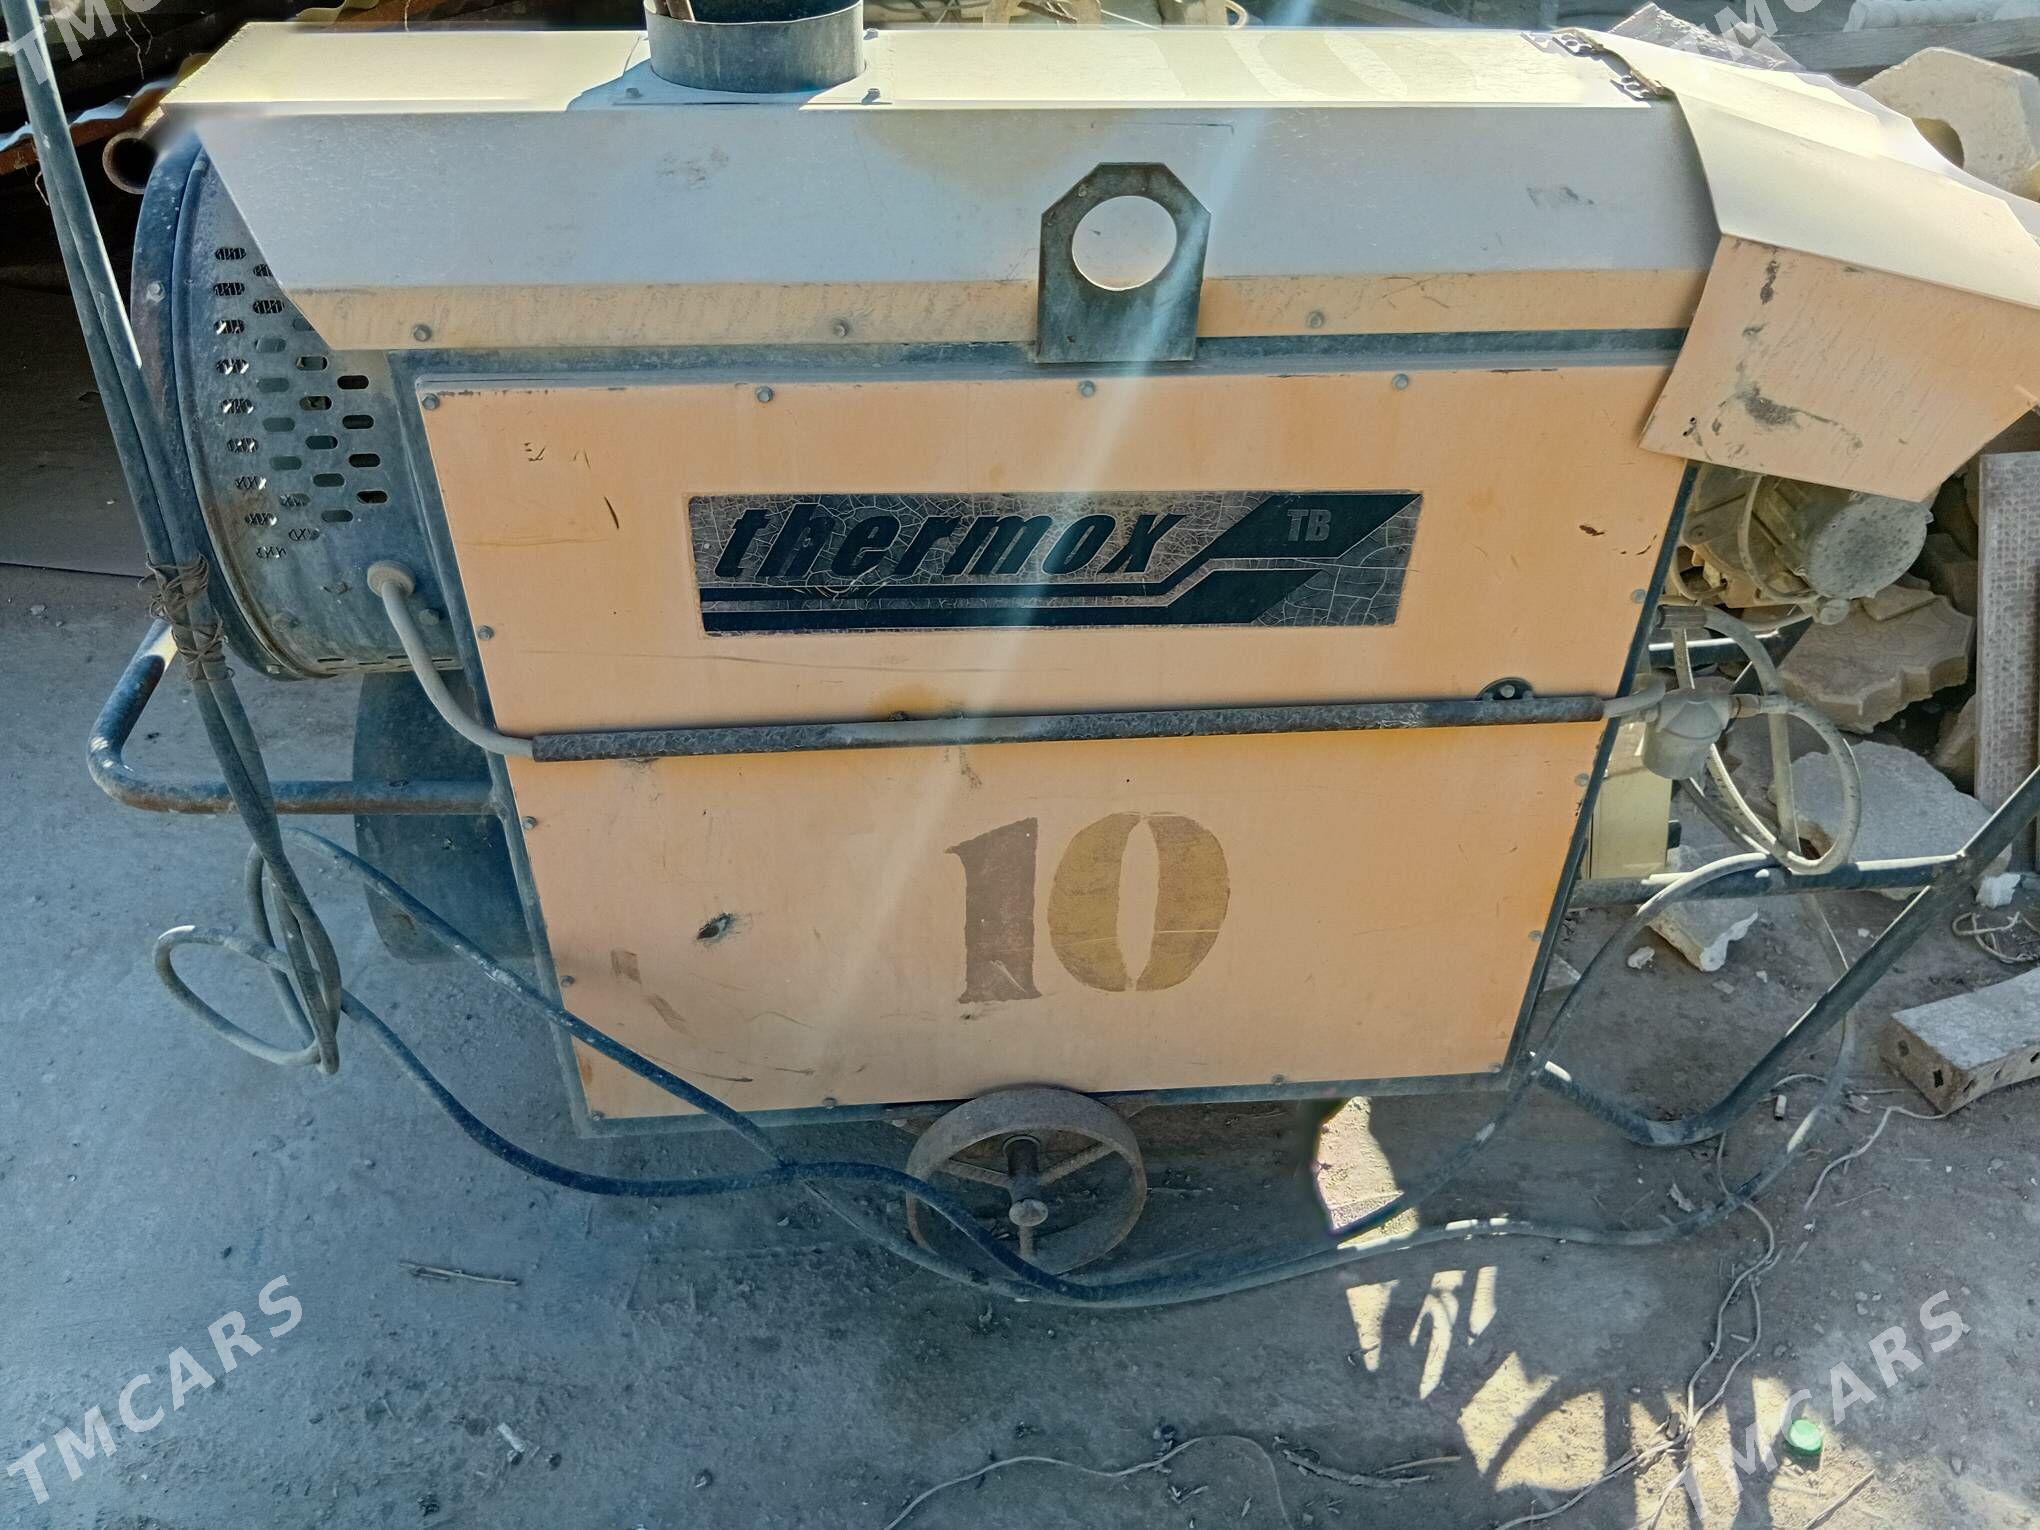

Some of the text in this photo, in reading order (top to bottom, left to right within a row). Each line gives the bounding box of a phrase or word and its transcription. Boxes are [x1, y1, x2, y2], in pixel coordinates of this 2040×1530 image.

[714, 502, 1332, 579] thermox TB
[943, 811, 1231, 1003] 10
